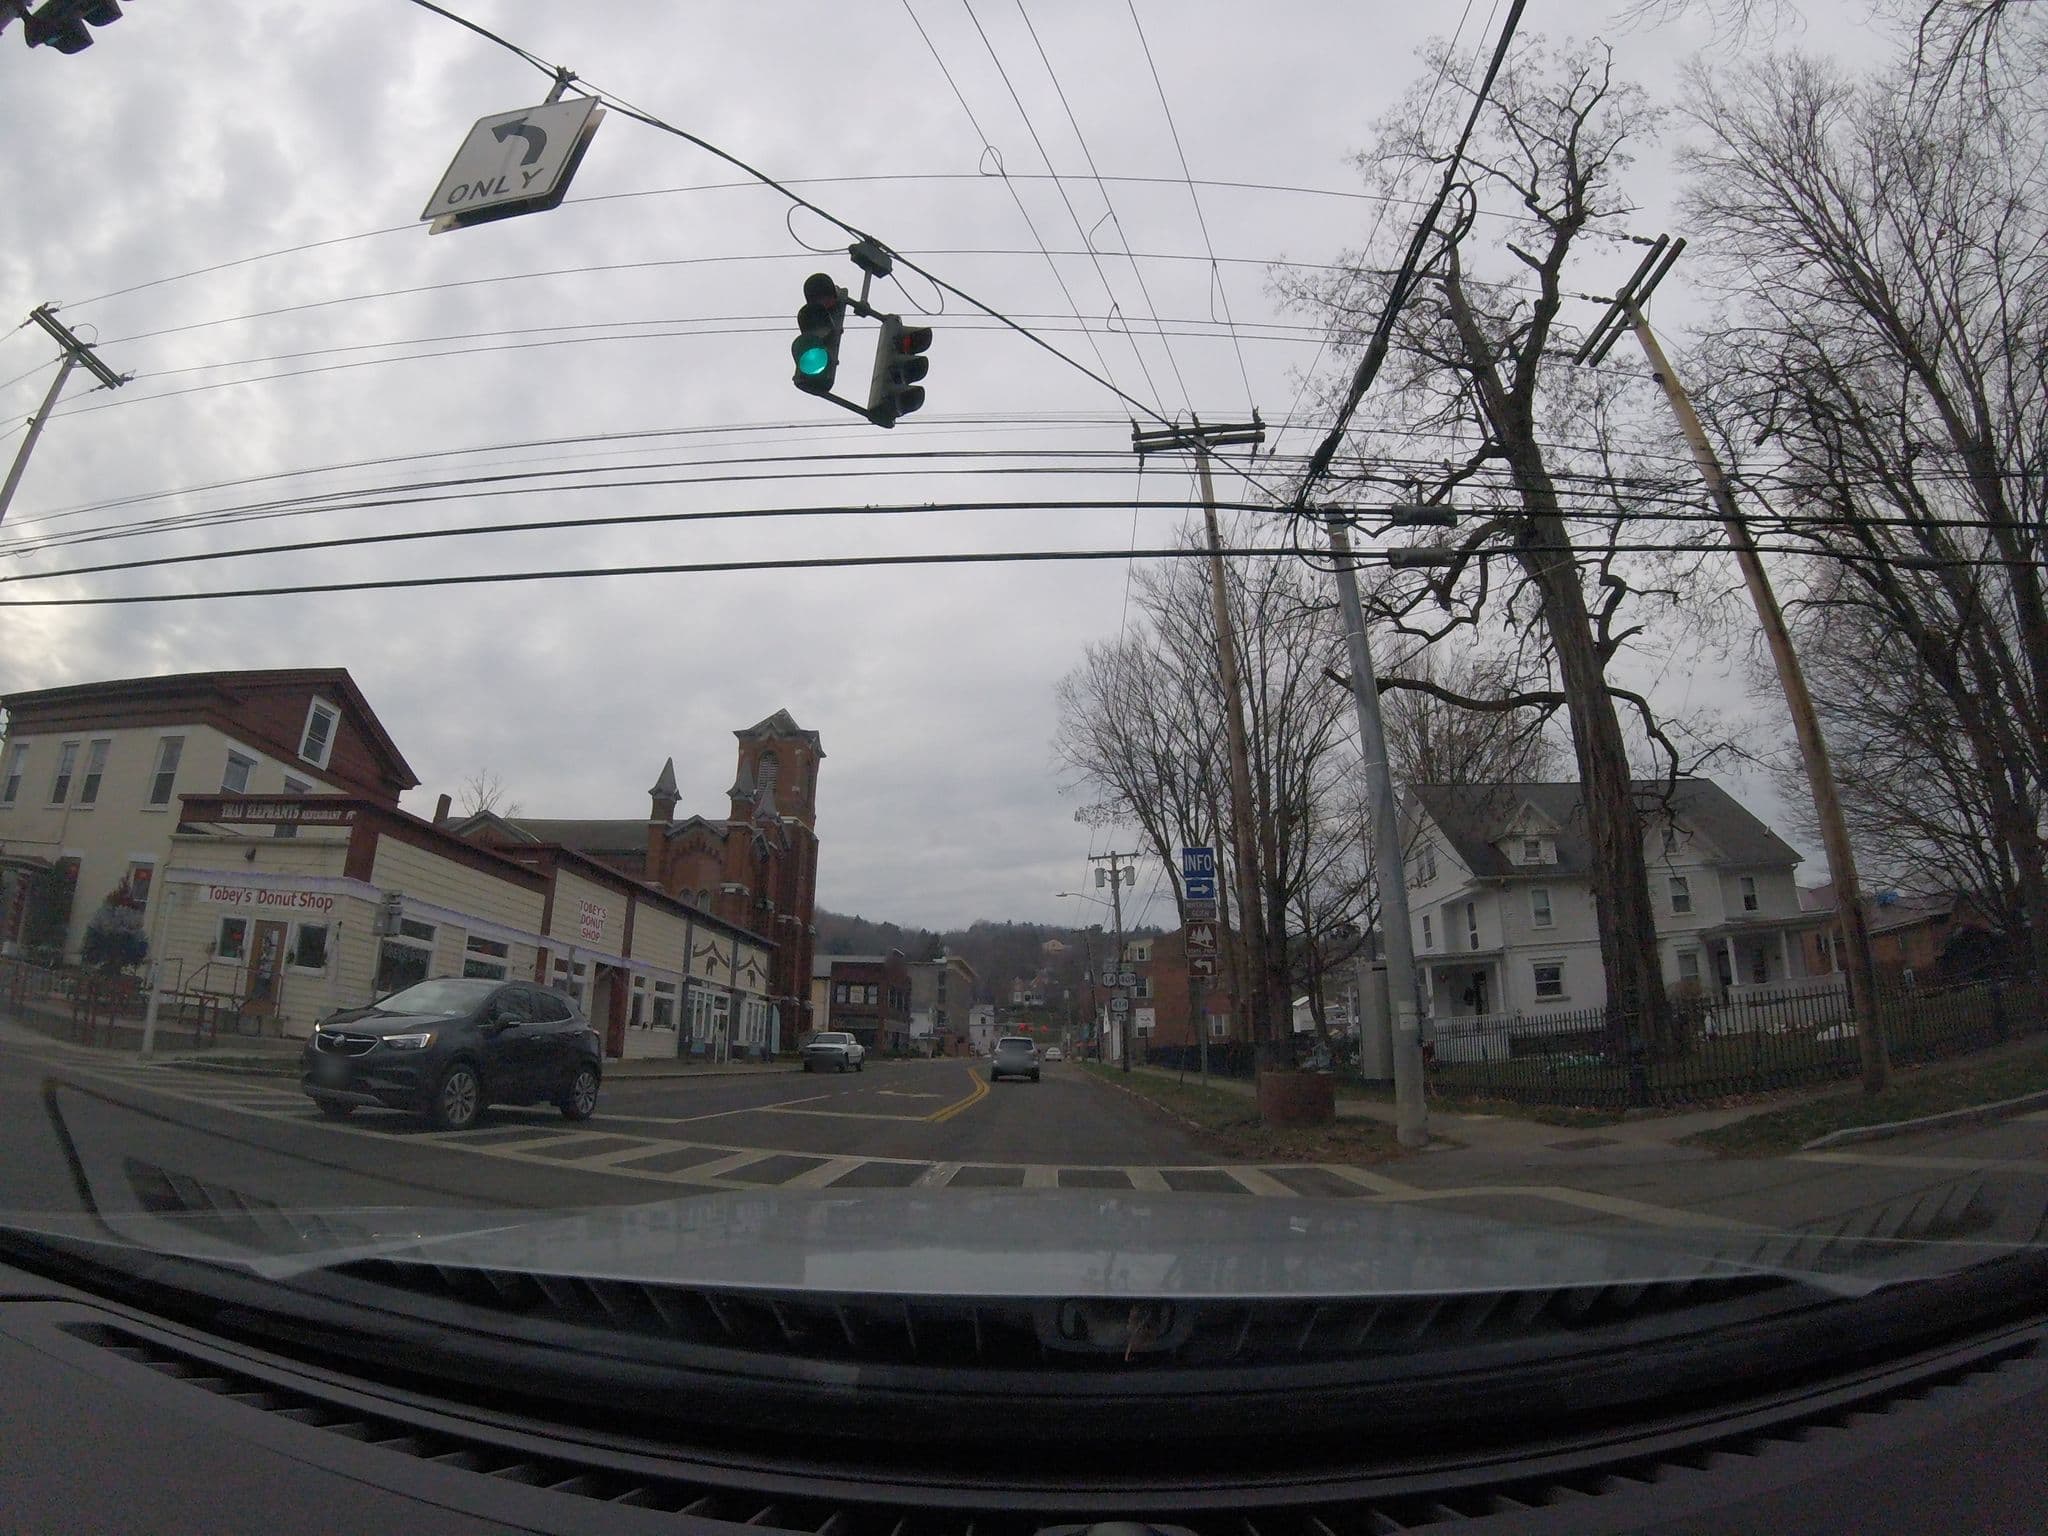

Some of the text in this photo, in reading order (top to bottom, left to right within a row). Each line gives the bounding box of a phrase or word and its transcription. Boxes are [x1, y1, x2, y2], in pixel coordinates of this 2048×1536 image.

[448, 168, 544, 205] ONLY
[1185, 854, 1212, 872] INFO
[208, 885, 333, 913] Tobey's Donut Shop
[580, 914, 604, 929] DONUT
[580, 927, 601, 941] SHOP
